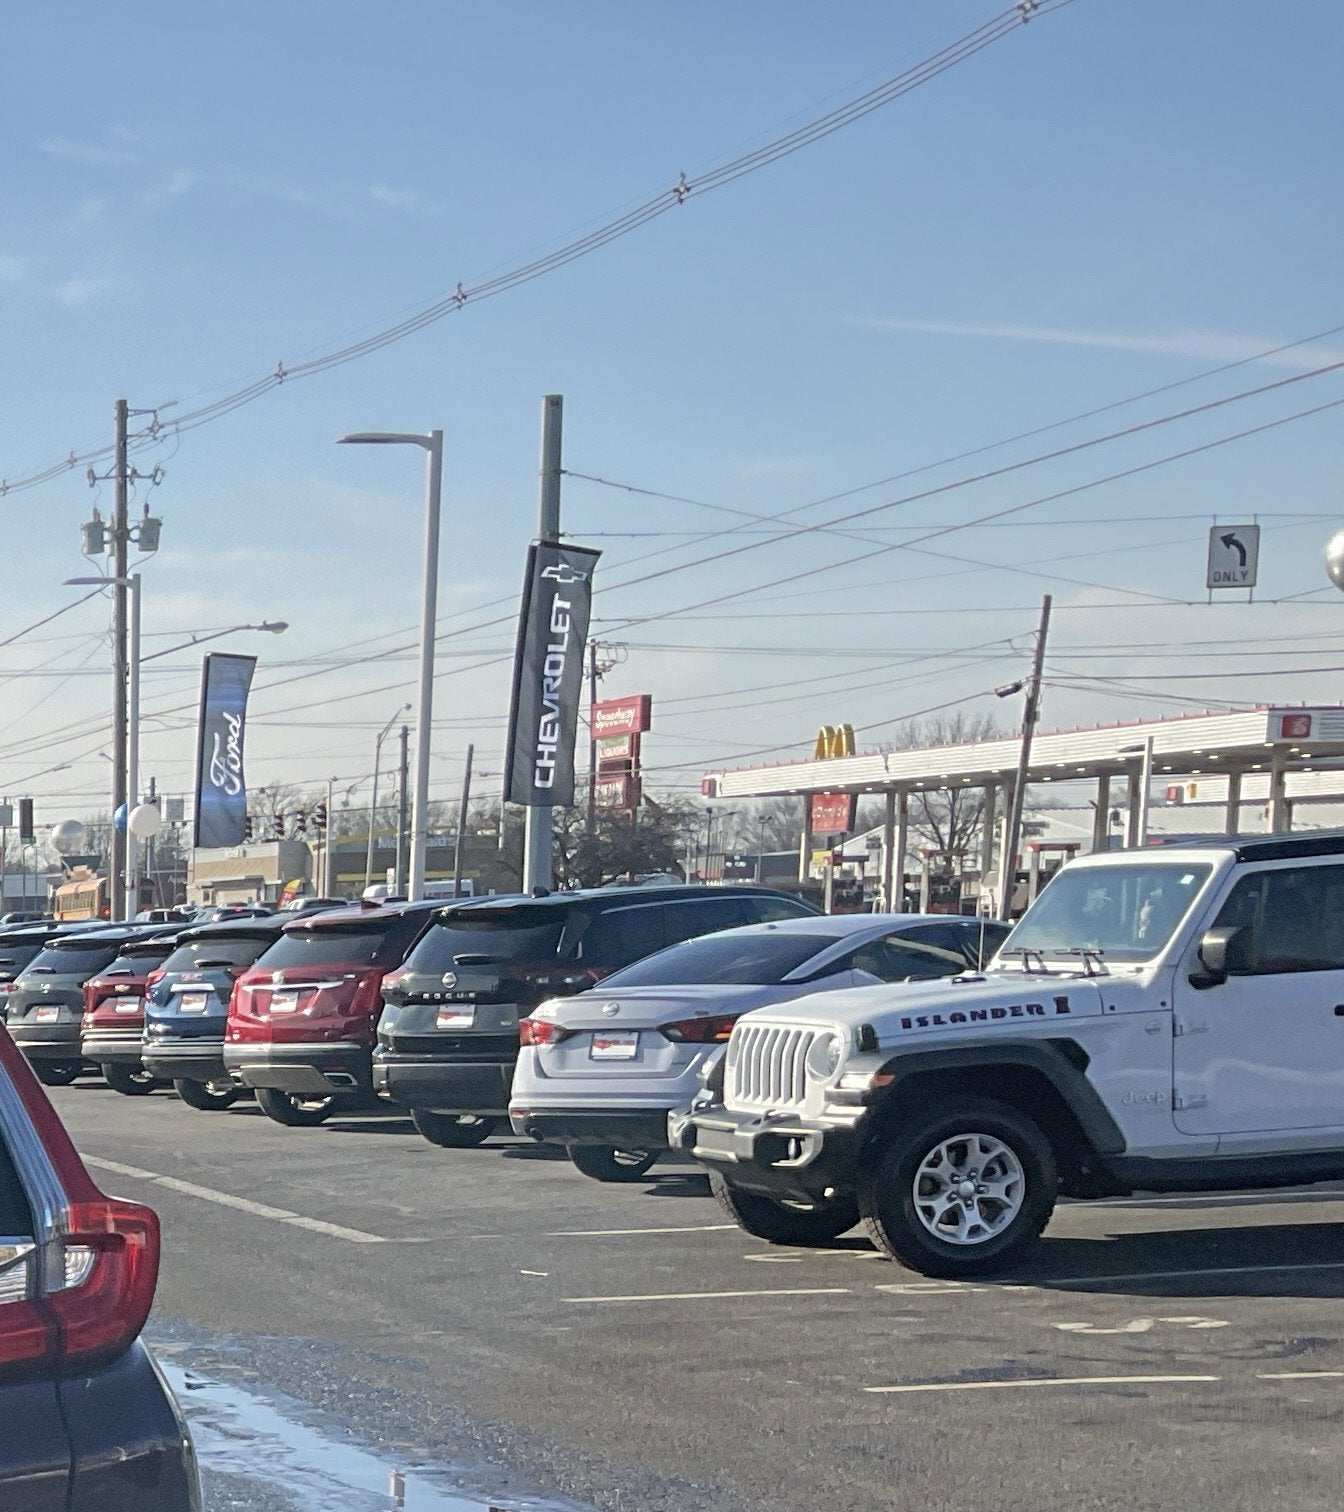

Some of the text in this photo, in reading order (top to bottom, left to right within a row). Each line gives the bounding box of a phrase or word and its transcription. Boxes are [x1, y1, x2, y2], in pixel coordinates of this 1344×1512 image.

[1213, 571, 1248, 582] ONLY
[534, 592, 572, 788] CHEVROLET
[210, 711, 242, 796] Ford
[901, 1003, 1046, 1029] ISLANDER
[1120, 1090, 1167, 1107] Jeep
